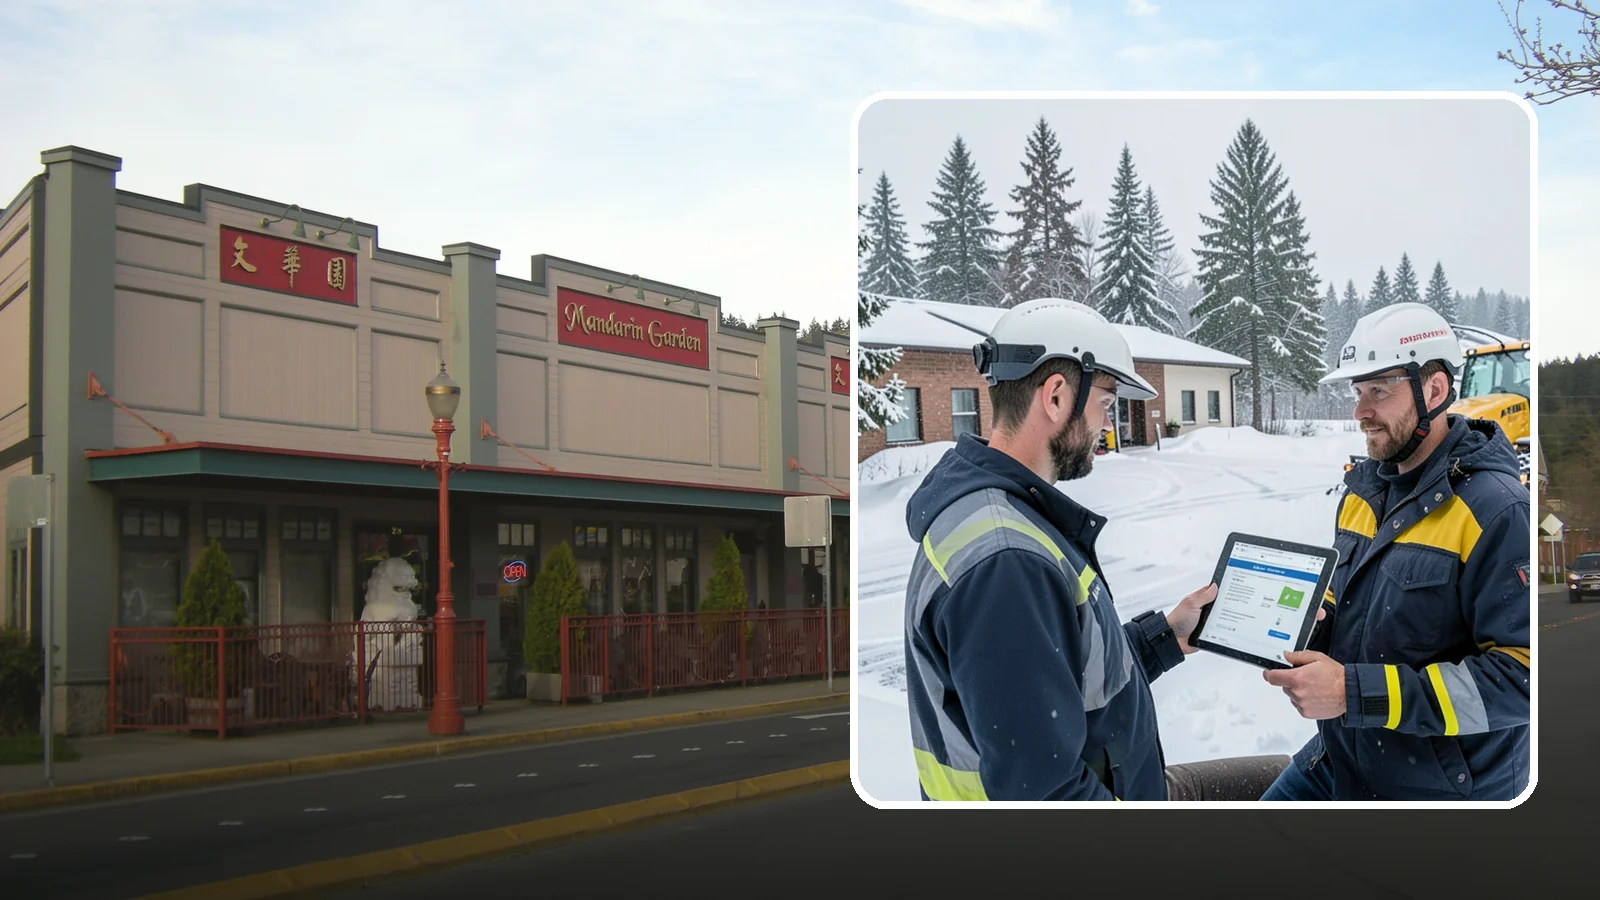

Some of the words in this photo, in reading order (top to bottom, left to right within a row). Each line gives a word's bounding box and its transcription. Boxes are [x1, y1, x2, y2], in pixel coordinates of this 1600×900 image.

[231, 236, 346, 290] 文華園
[564, 302, 644, 341] Mandarin
[648, 320, 702, 352] Garden
[503, 565, 527, 579] OPEN
